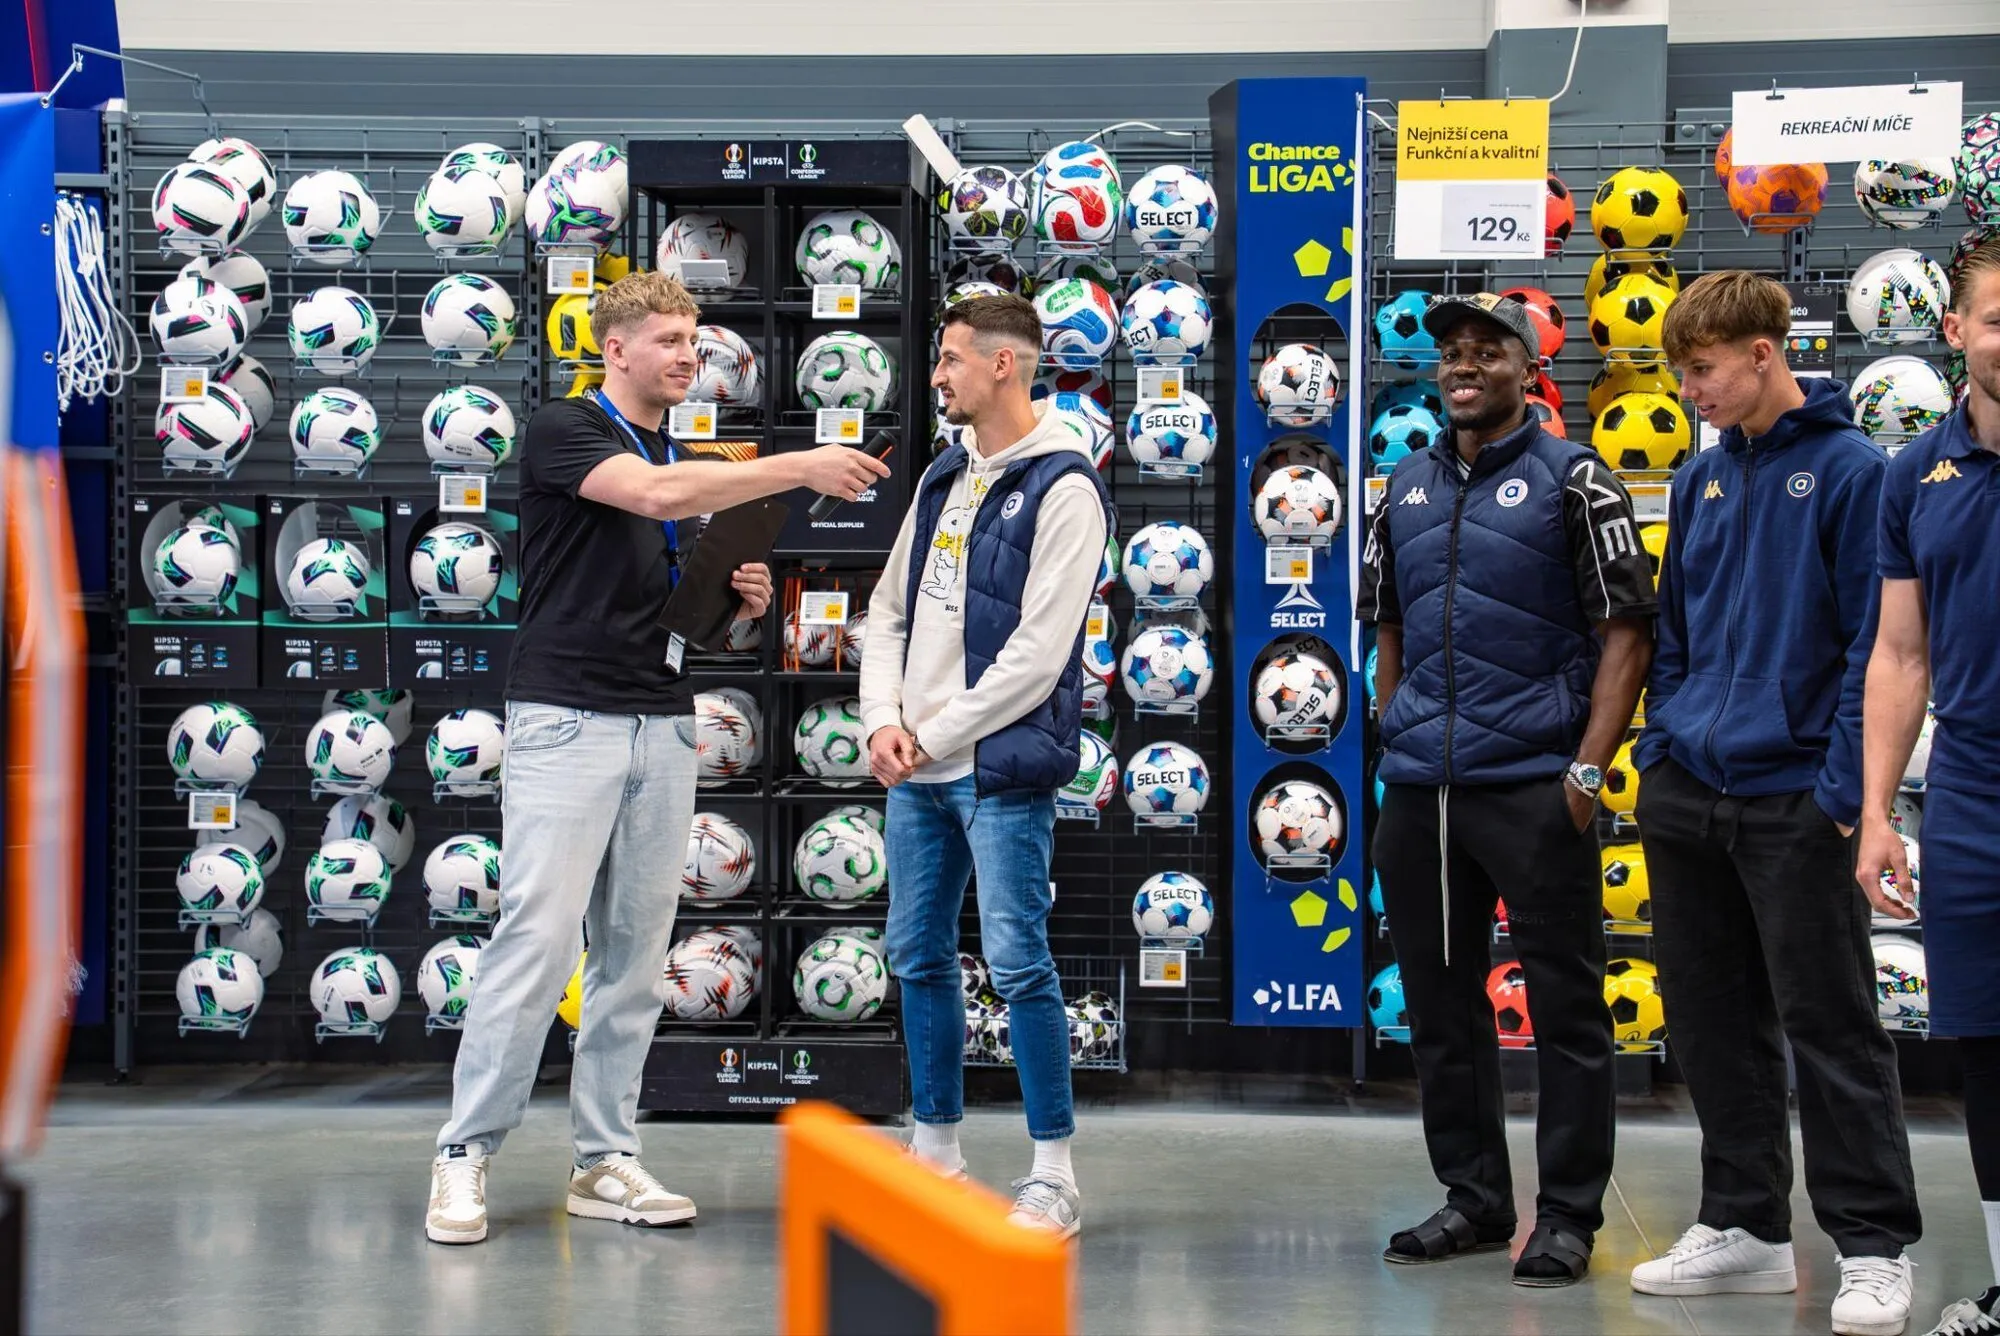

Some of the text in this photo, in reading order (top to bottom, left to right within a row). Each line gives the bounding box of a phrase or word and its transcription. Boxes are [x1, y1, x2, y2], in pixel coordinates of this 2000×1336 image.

[1780, 114, 1913, 135] REKREAČNÍ MÍČE
[1407, 127, 1509, 144] Nejnižší cena
[1248, 143, 1341, 160] Chance
[1406, 145, 1541, 160] Funkční a kvalitní
[753, 157, 784, 166] KIPSTA
[1249, 165, 1335, 193] LIGA
[1140, 211, 1193, 226] SELECT
[1467, 216, 1530, 242] 129 Kč
[1304, 358, 1323, 403] SELECT
[1146, 415, 1197, 429] SELECT
[1270, 612, 1326, 628] SELECT
[1287, 694, 1321, 732] SELEC
[1137, 771, 1184, 787] SELECT
[1153, 888, 1197, 901] SELECT
[1288, 984, 1342, 1011] LFA
[747, 1062, 778, 1071] KIPSTA
